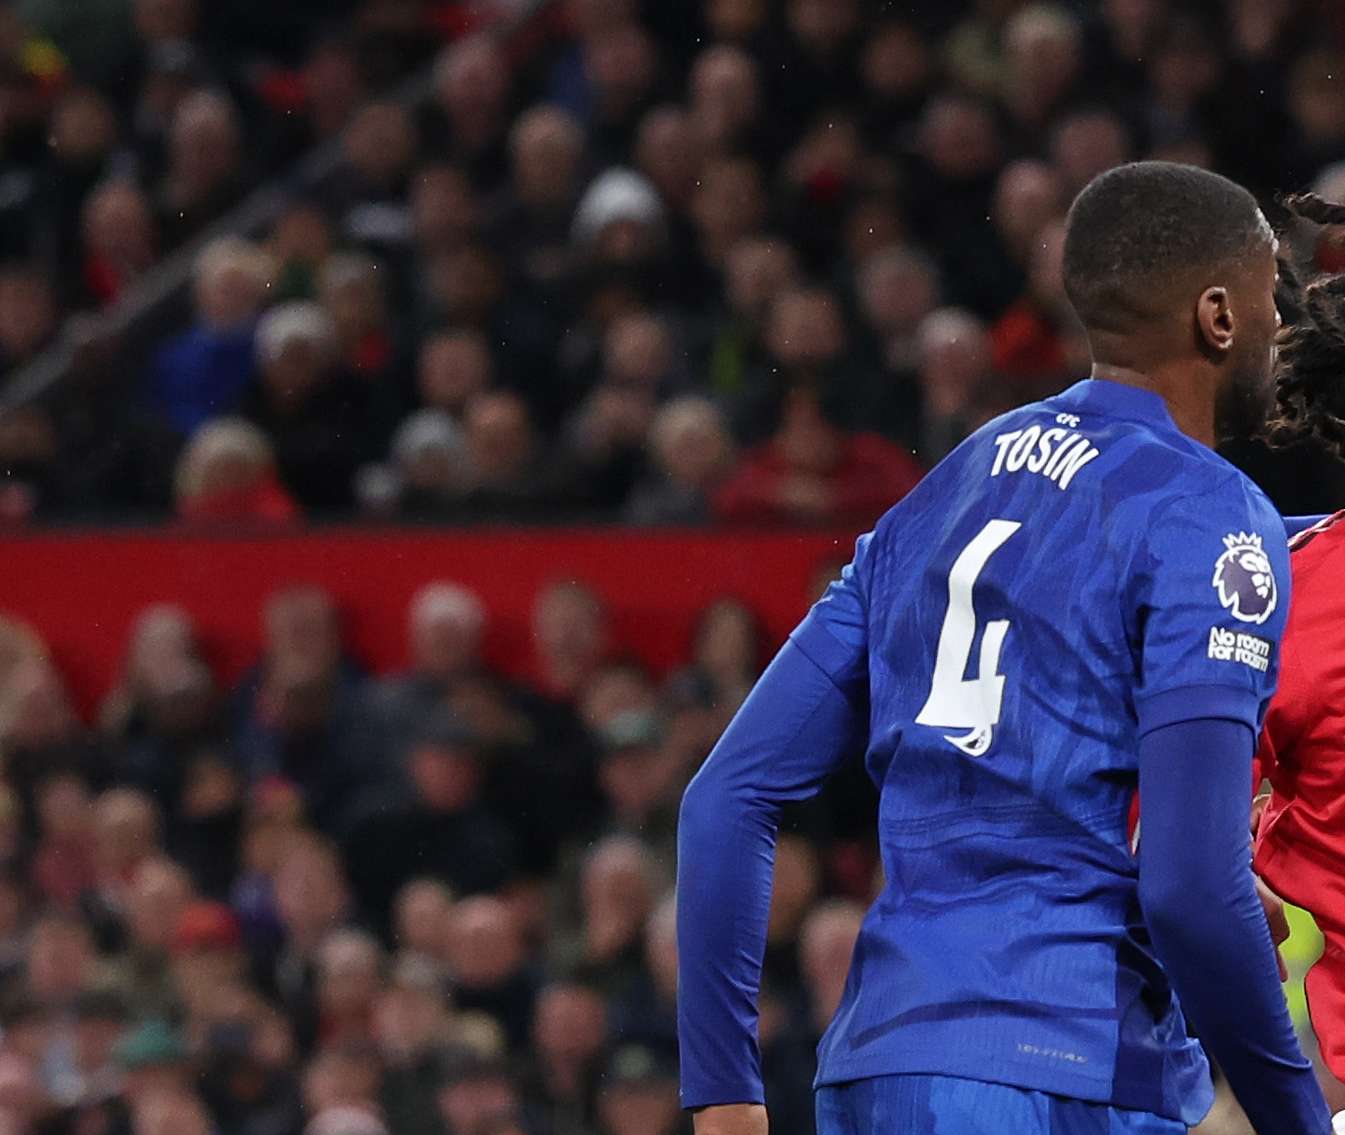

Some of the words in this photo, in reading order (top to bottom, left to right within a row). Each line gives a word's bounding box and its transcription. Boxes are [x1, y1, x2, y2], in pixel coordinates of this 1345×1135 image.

[991, 425, 1099, 490] TOSIN
[914, 518, 1022, 757] 4
[1209, 626, 1236, 647] No
[1236, 633, 1270, 657] room
